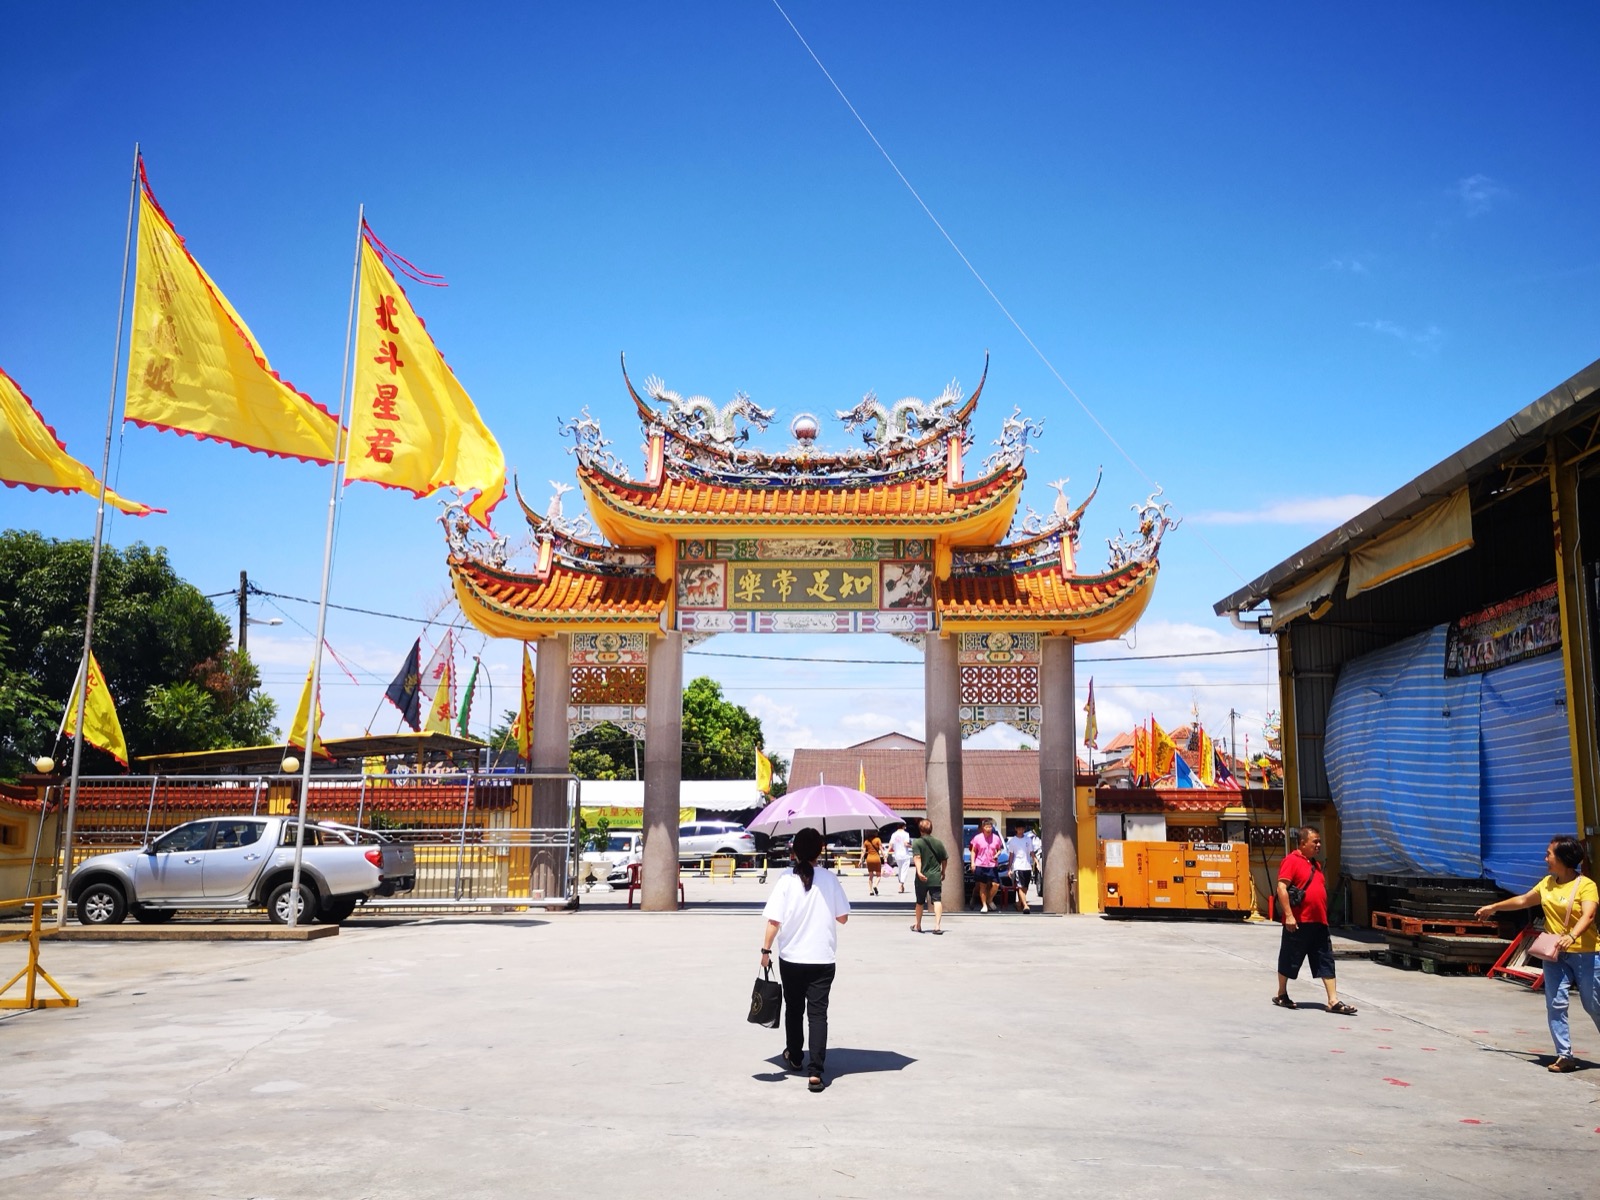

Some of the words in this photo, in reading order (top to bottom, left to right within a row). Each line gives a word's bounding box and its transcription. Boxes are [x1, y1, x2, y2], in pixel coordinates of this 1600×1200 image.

[365, 294, 404, 464] 北斗星君
[1222, 843, 1231, 851] 60
